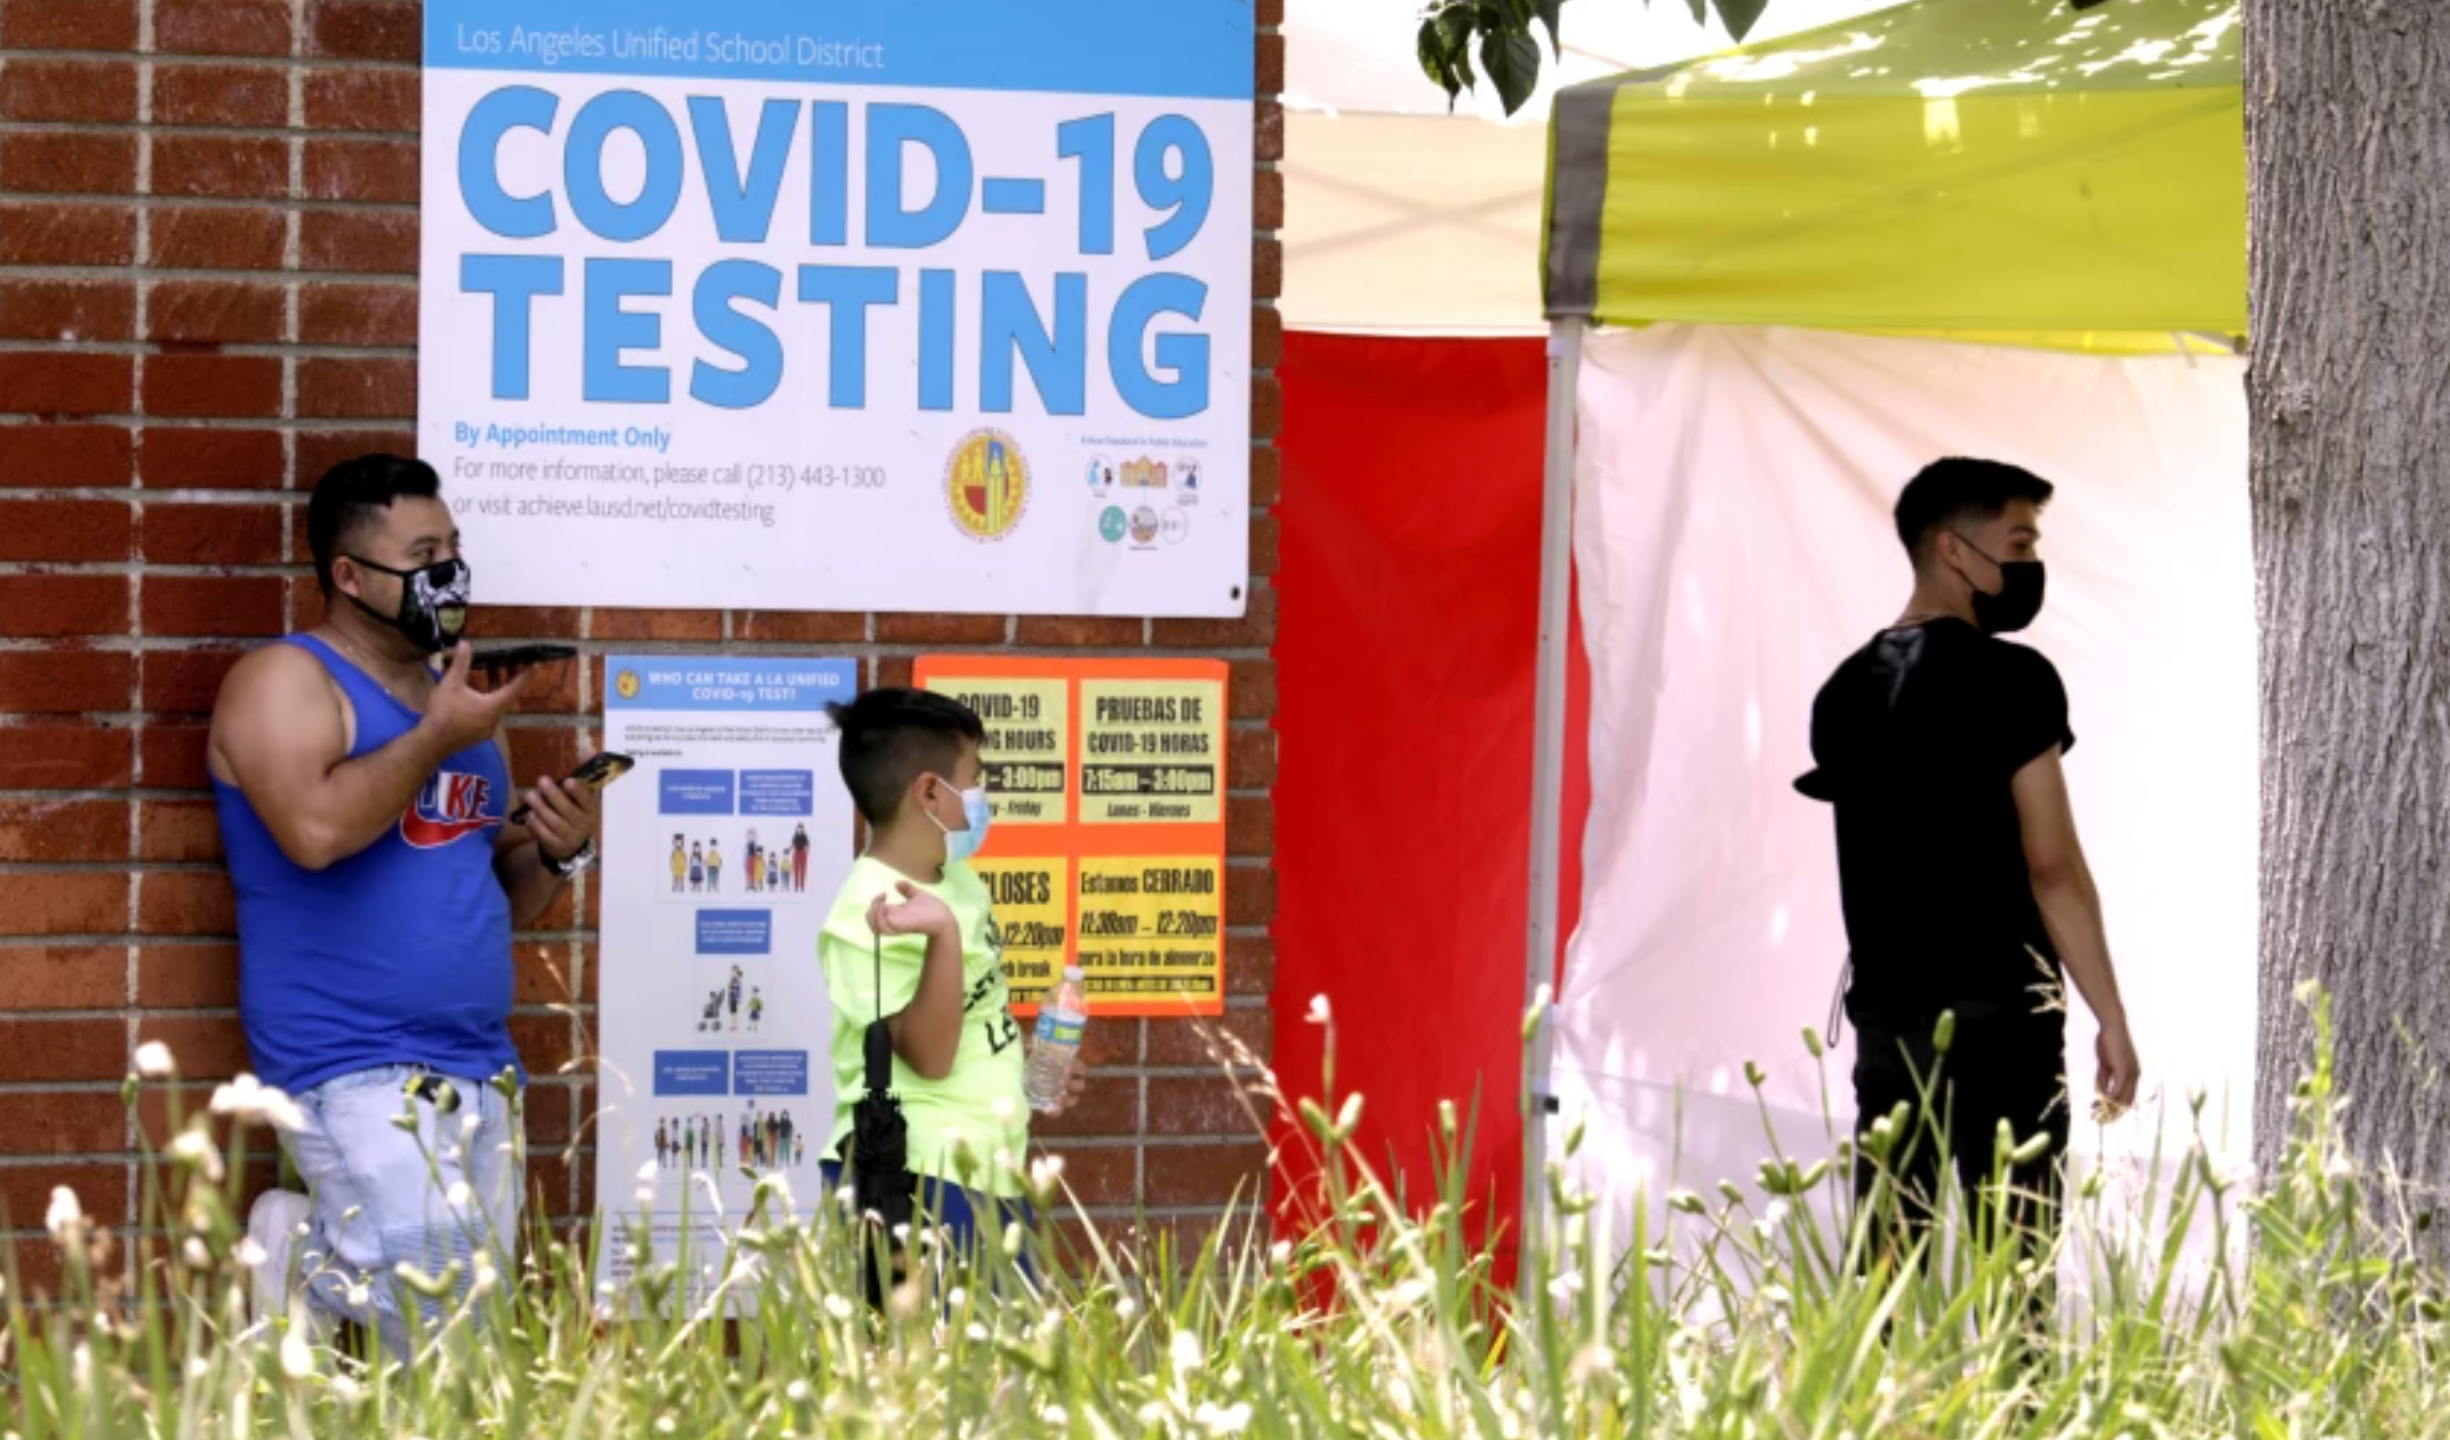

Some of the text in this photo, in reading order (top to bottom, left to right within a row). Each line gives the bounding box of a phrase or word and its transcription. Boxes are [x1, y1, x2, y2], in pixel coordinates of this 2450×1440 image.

[458, 23, 885, 69] Los Angeles Unified School District
[457, 85, 1214, 261] COVID-19
[459, 252, 1211, 420] TESTING
[455, 421, 672, 453] By Appointment Only
[454, 456, 887, 491] For more information, please call (213) 443-1300
[453, 496, 776, 527] or visit achieve.lausd.net/covidtesting
[648, 671, 840, 687] WHO CAN TAKE A LA UNIFIED
[692, 686, 797, 704] COVID-19 TEST?
[1096, 697, 1203, 722] PRUEBAS DE
[1005, 728, 1056, 751] HOURS
[1088, 731, 1209, 754] COVID-19 HORAS
[1002, 766, 1062, 791] 3:00pm
[1084, 769, 1139, 791] 7:15am
[1154, 769, 1212, 793] 3:00pm
[1107, 801, 1140, 818] Lunes
[1081, 869, 1213, 894] Estamos CERRADO
